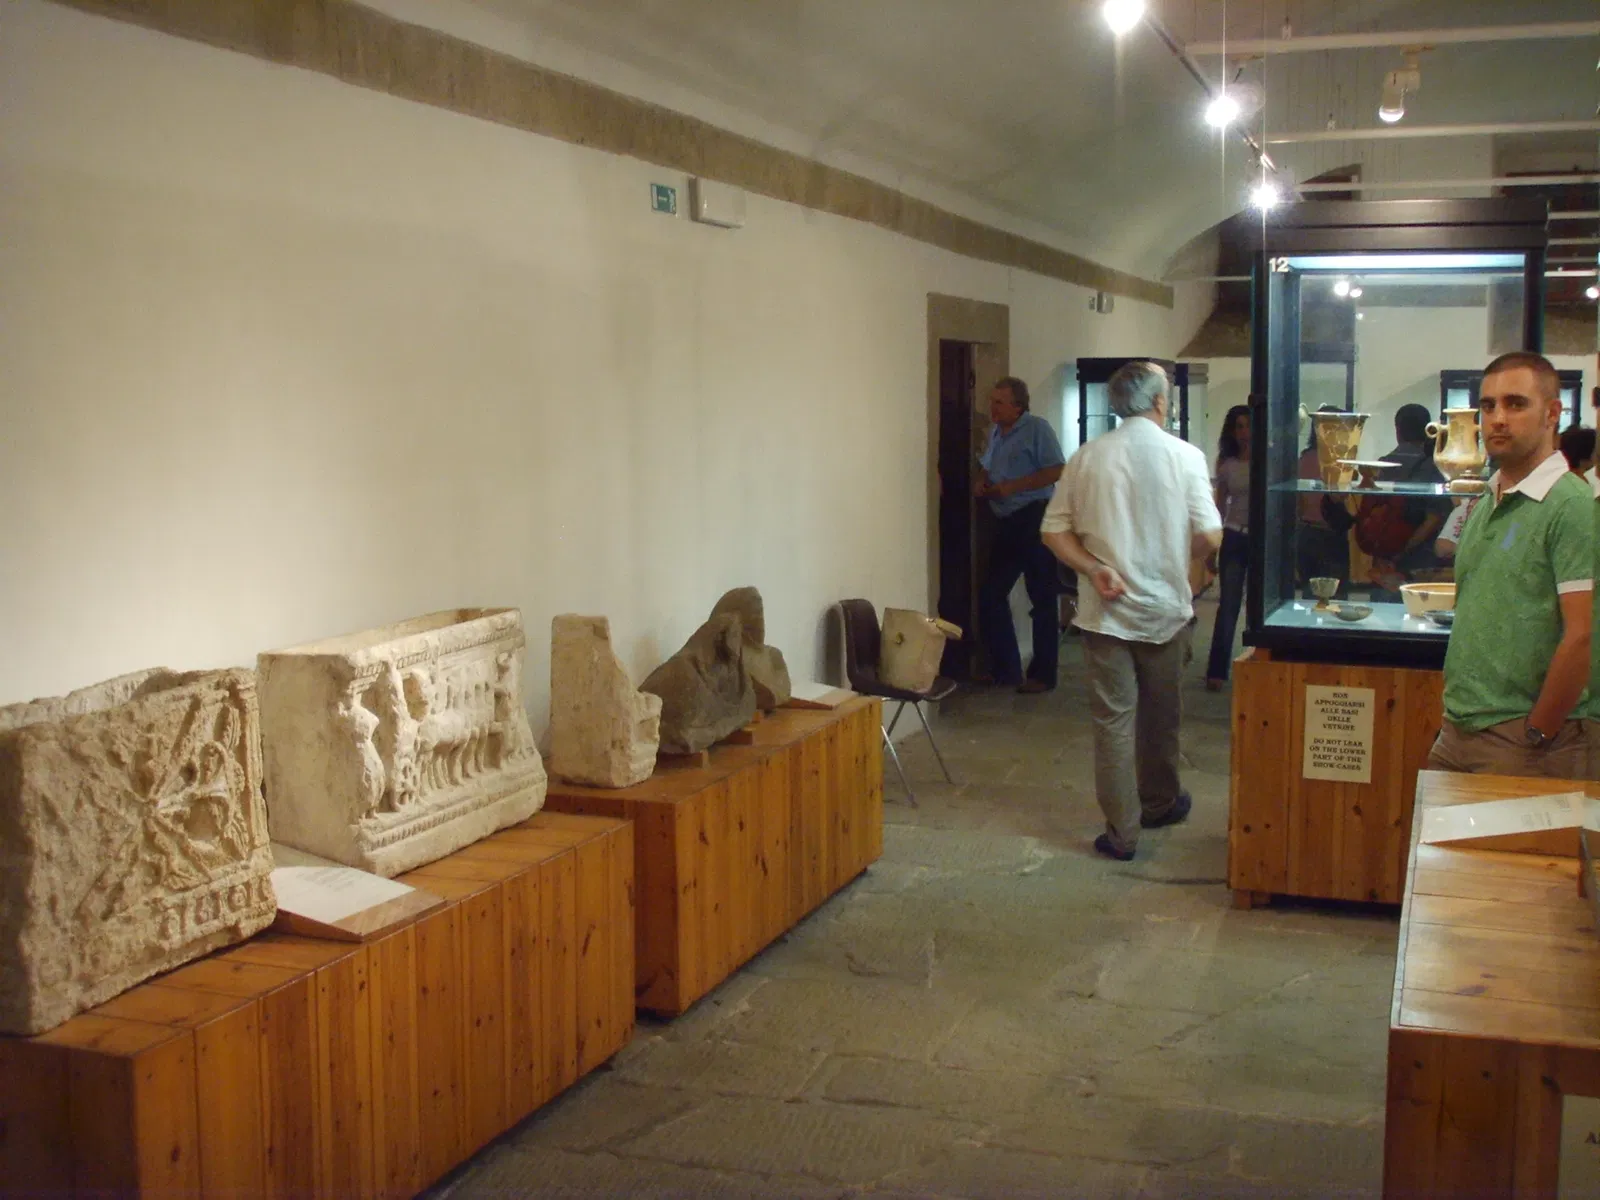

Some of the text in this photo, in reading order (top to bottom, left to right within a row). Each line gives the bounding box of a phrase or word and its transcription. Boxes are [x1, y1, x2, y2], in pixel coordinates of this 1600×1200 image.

[1269, 257, 1288, 272] 12
[1341, 708, 1359, 716] BASI
[1327, 715, 1351, 723] DELLE
[1322, 723, 1356, 731] VETRINE
[1339, 748, 1366, 756] LOWER
[1312, 753, 1332, 761] PART
[1347, 756, 1362, 764] THE
